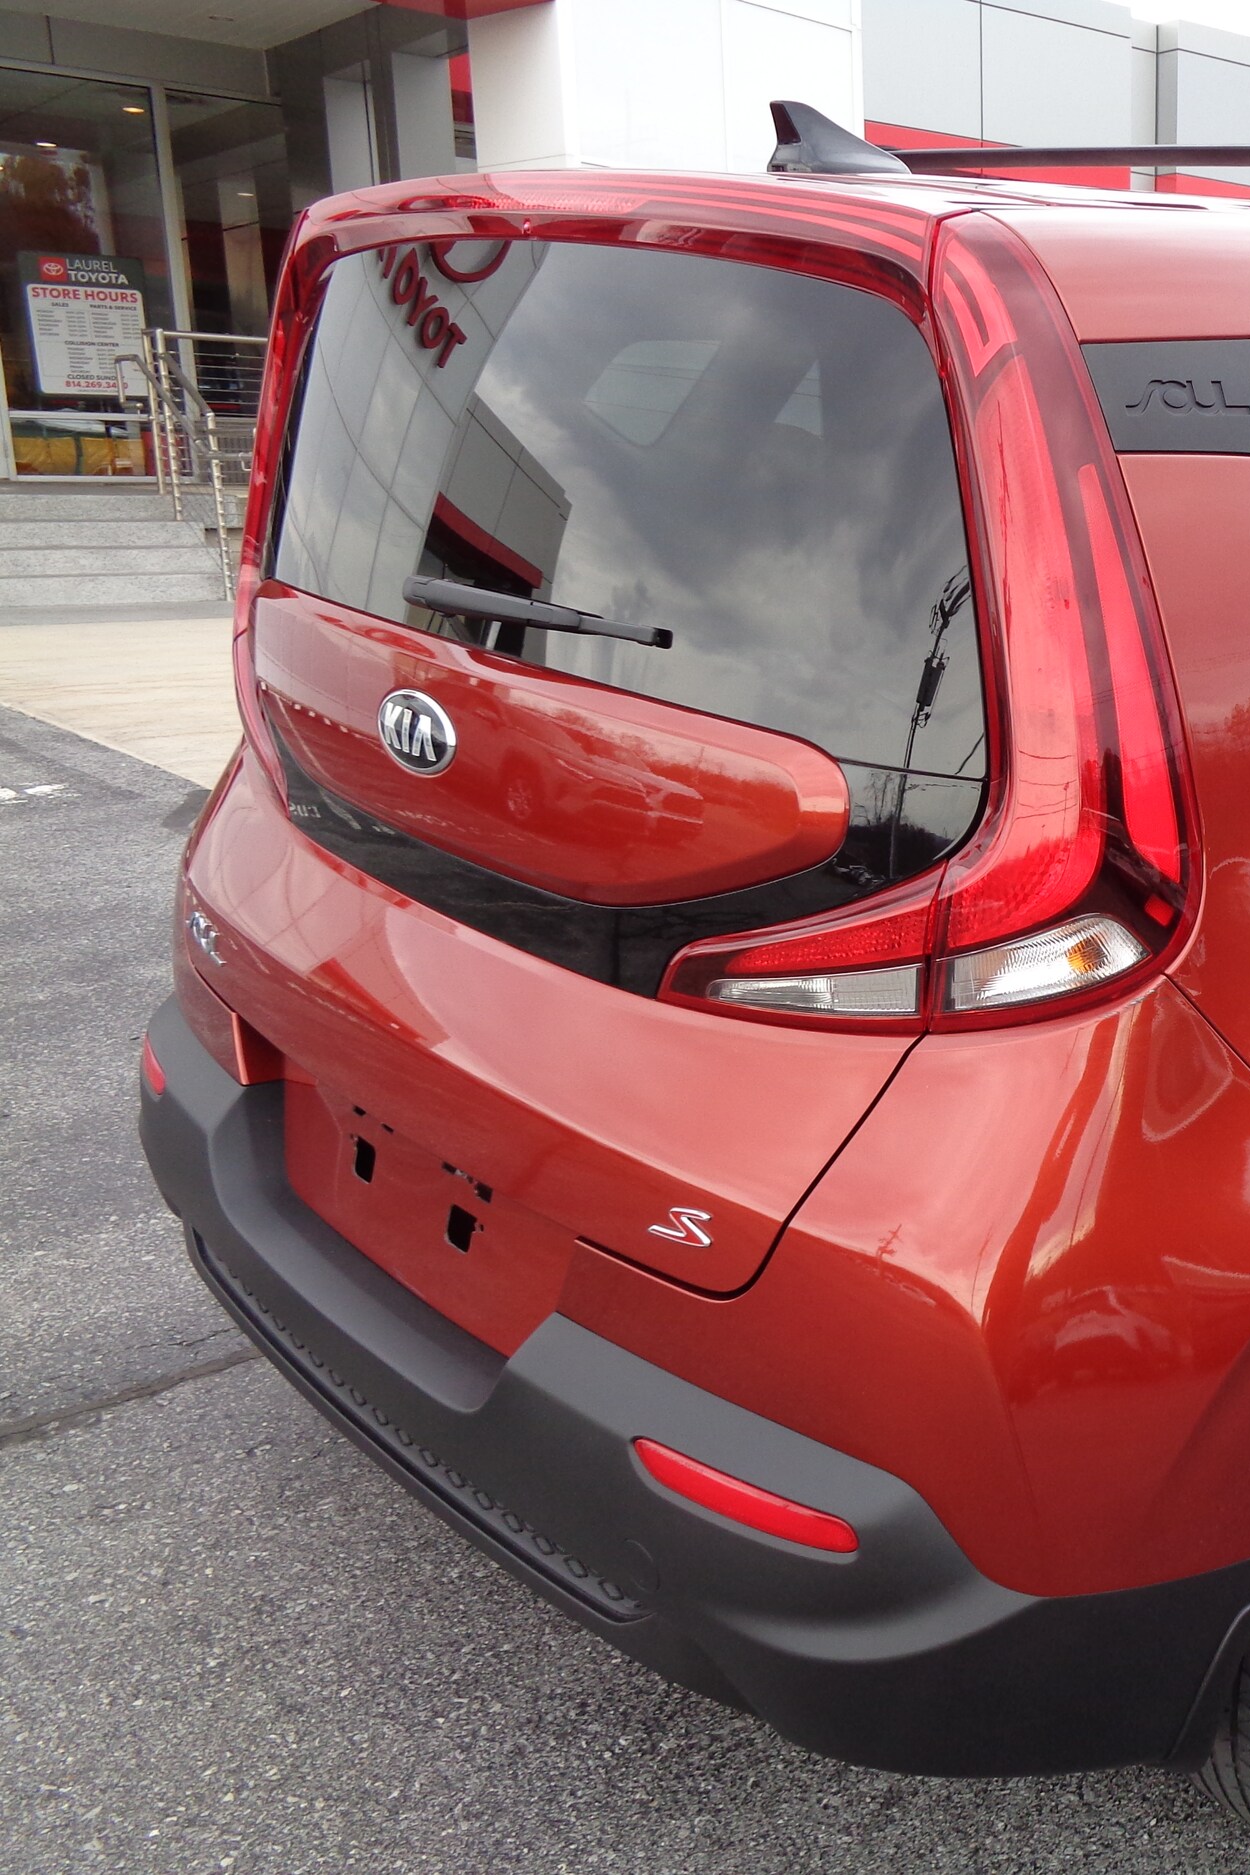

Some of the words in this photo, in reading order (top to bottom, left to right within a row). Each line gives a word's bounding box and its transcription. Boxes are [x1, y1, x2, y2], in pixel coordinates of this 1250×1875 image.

[66, 258, 118, 272] LAUREL
[68, 271, 129, 285] TOYOTA
[31, 287, 80, 300] STORE
[84, 290, 138, 303] HOURS
[67, 373, 95, 381] CLOSED
[65, 381, 128, 389] 814.269.340
[384, 702, 437, 762] KIA
[648, 1207, 711, 1247] S
